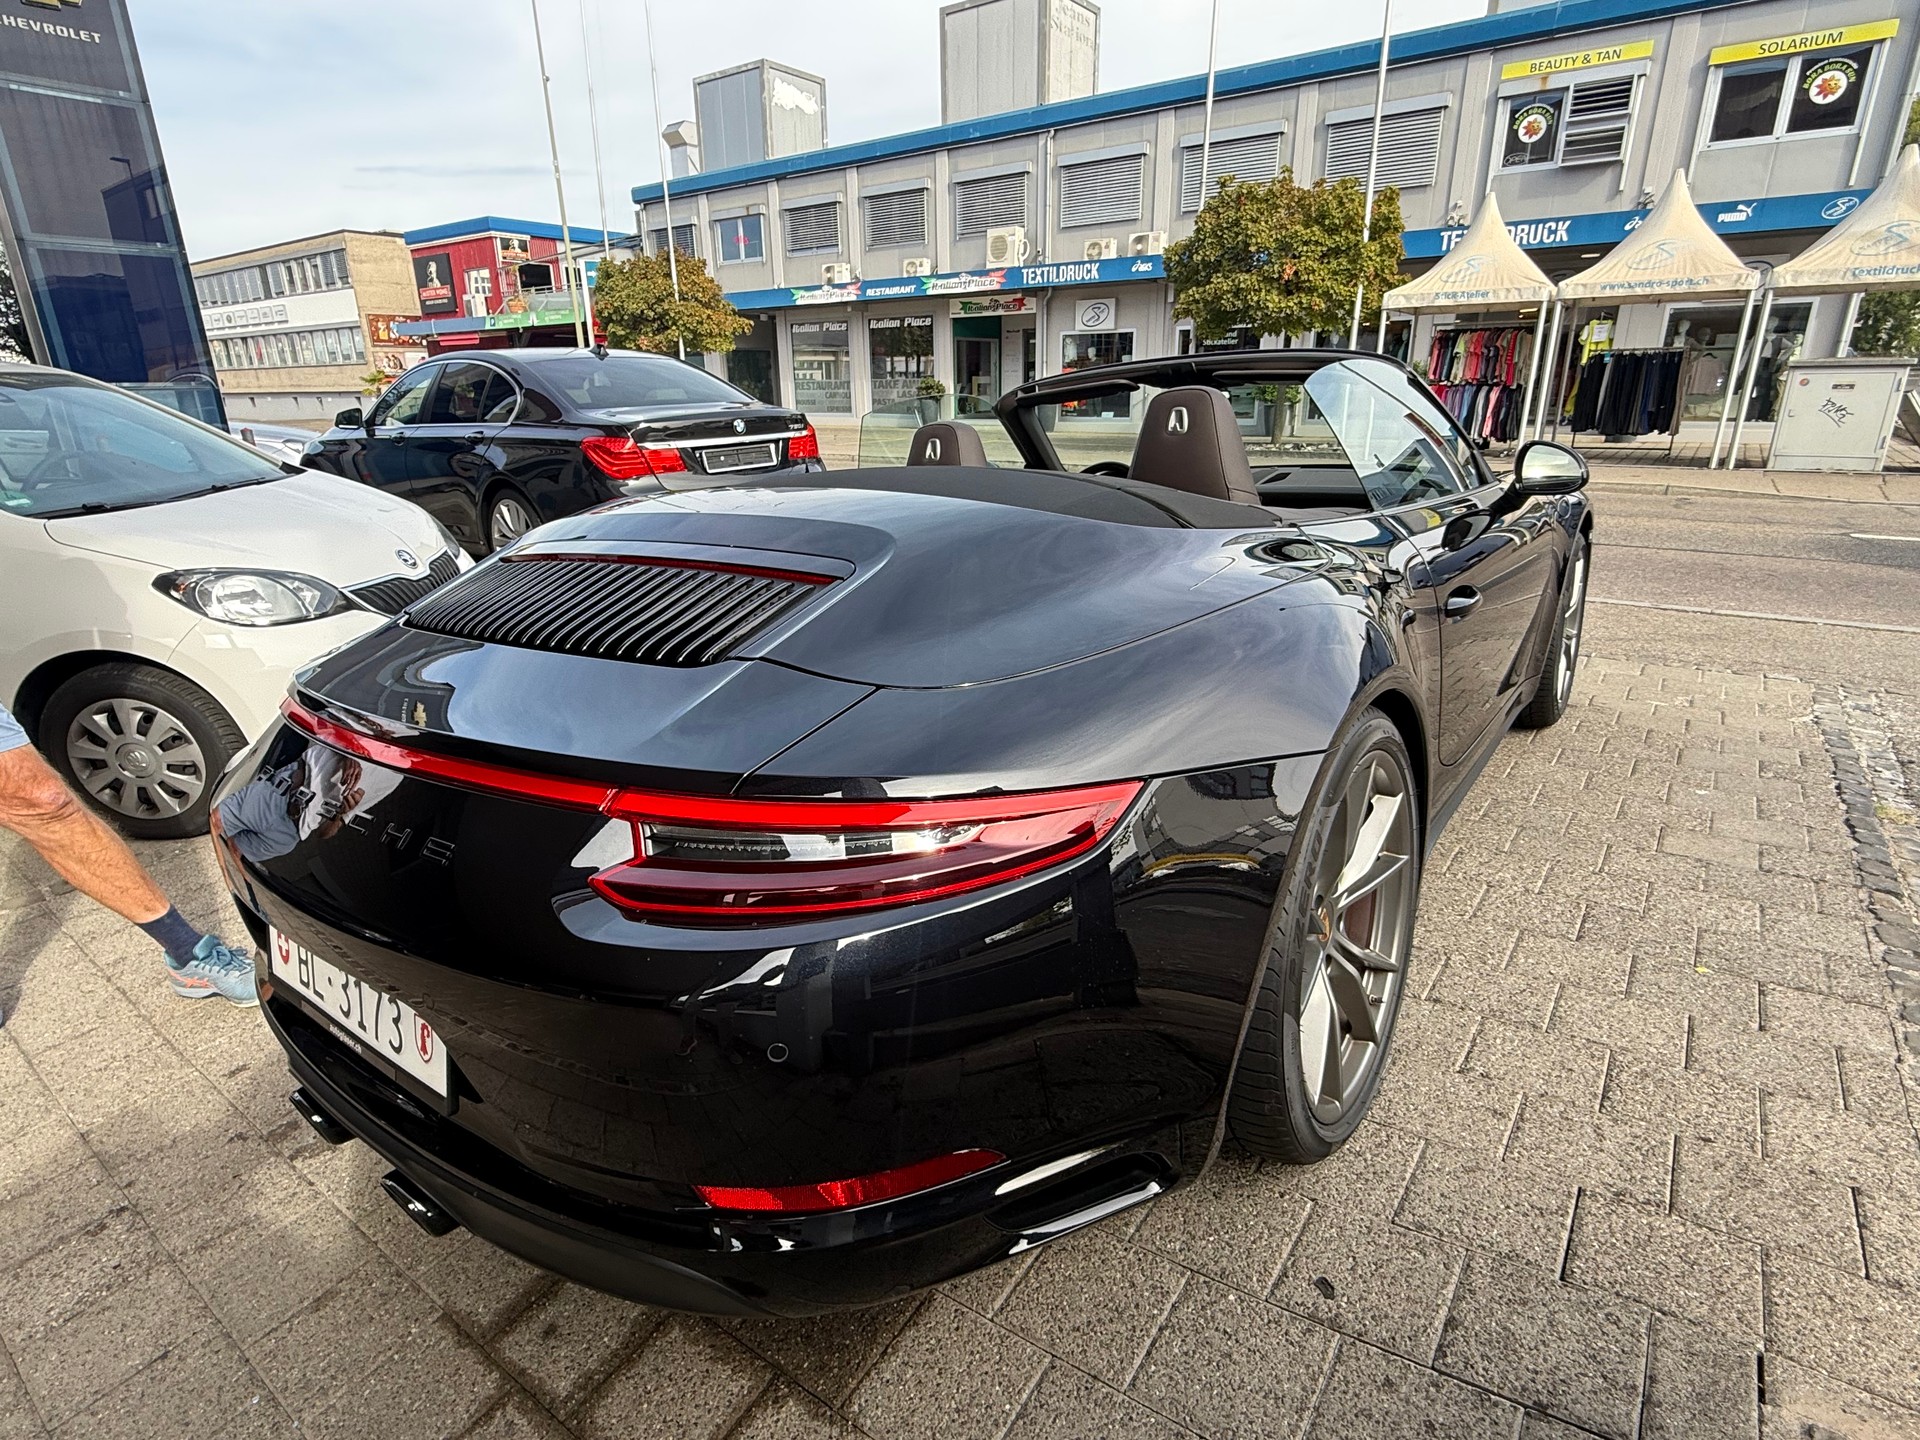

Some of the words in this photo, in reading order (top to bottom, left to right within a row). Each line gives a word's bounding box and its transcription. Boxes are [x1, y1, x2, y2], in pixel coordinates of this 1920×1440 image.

[0, 14, 101, 44] HEVROLET
[1758, 31, 1844, 55] SOLARIUM
[1529, 55, 1579, 73] BEAUTY
[1581, 54, 1592, 65] &
[1596, 49, 1622, 63] TAN
[1803, 68, 1823, 89] BORA
[1824, 62, 1846, 72] BORA
[1717, 211, 1747, 223] PUMA
[1440, 219, 1572, 252] TEDRUCK
[967, 276, 996, 288] Place
[1022, 262, 1100, 285] TEXTILDRUCK
[866, 284, 917, 297] RESTAURANT
[967, 303, 993, 314] Italian
[995, 302, 1018, 311] Place
[792, 323, 820, 334] Italian
[823, 322, 848, 332] Place
[870, 319, 901, 329] Italian
[904, 317, 932, 327] Place
[256, 764, 456, 867] PORSCHE
